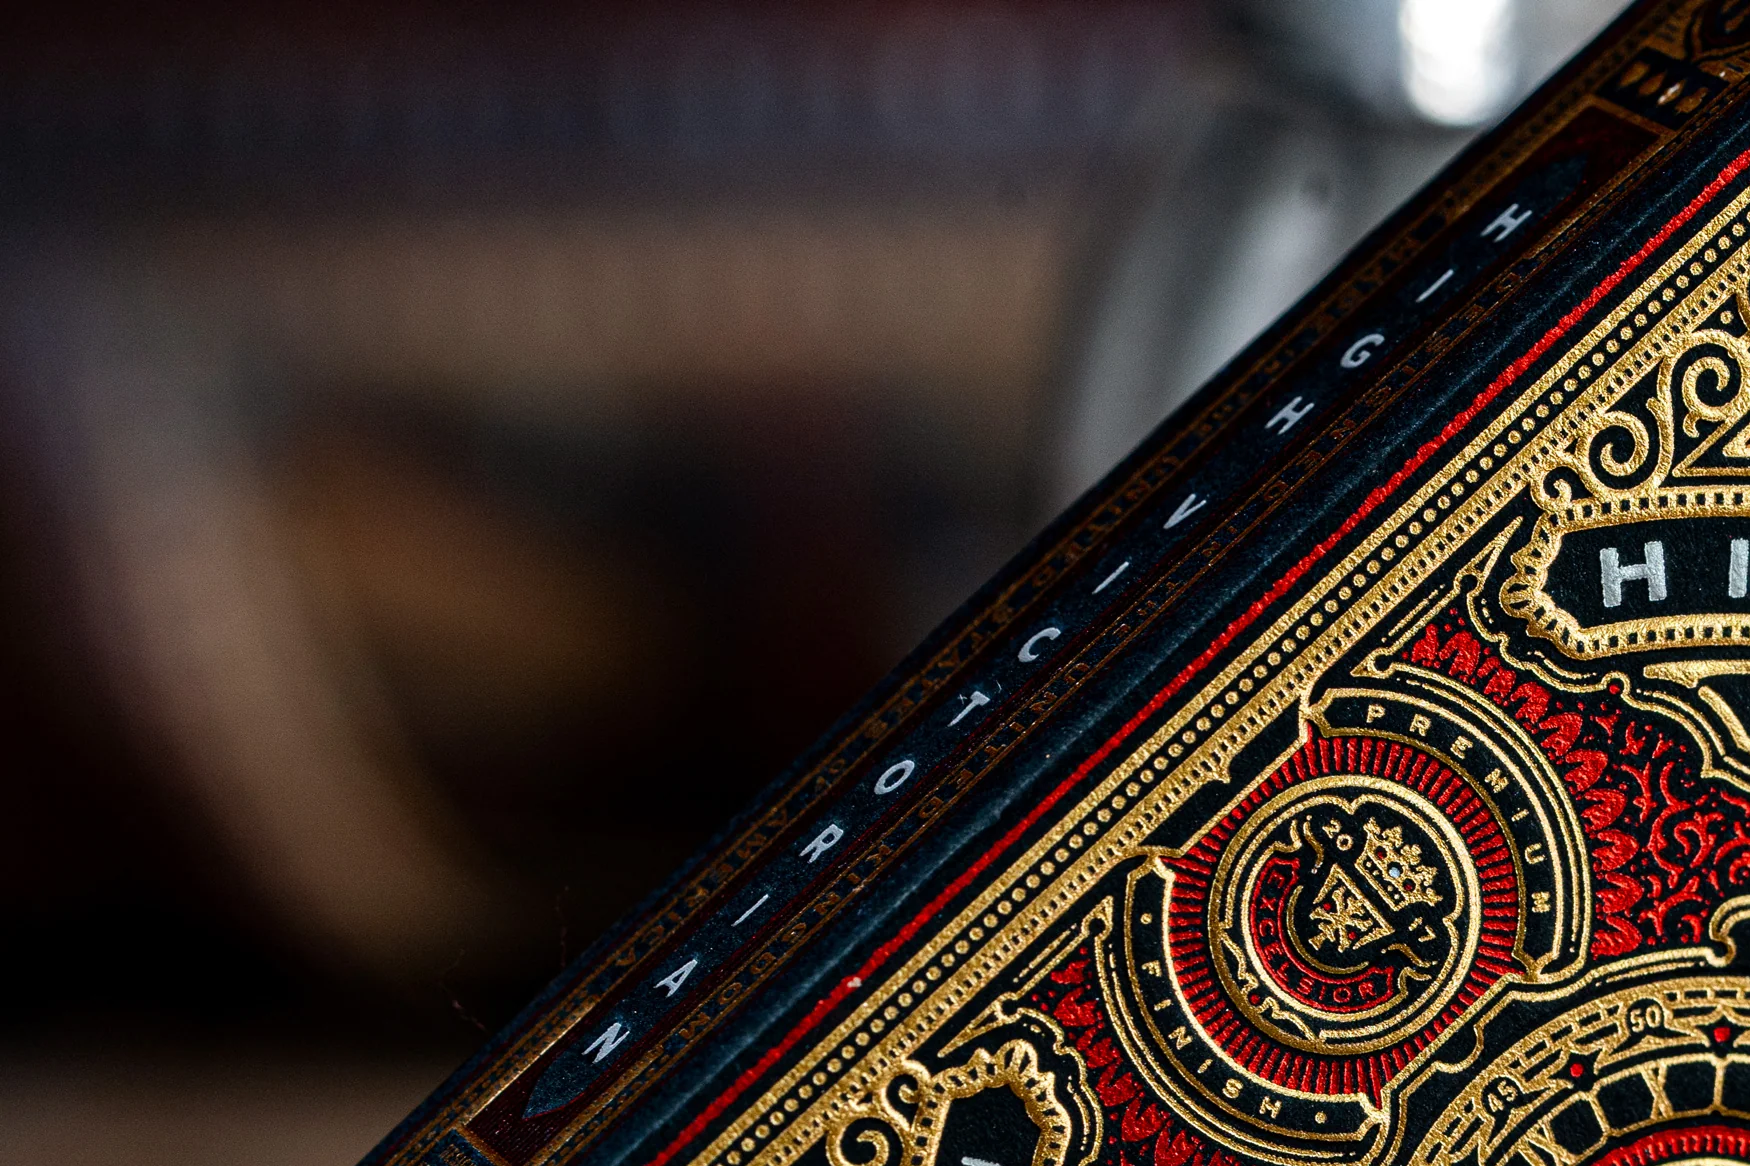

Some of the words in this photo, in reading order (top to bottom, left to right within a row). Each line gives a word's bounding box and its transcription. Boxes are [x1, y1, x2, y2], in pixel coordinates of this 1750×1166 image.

[1265, 203, 1533, 435] HIGH
[581, 494, 1206, 1064] VICTORIAN
[913, 658, 1091, 822] UNITED
[1366, 704, 1551, 913] PREMIUM
[1322, 819, 1354, 851] 20
[675, 841, 894, 1042] KINGDOM
[1259, 871, 1376, 1003] EXCELSIOR
[1142, 960, 1281, 1118] FINISH
[1488, 1081, 1518, 1113] 45
[1630, 1006, 1661, 1032] 50
